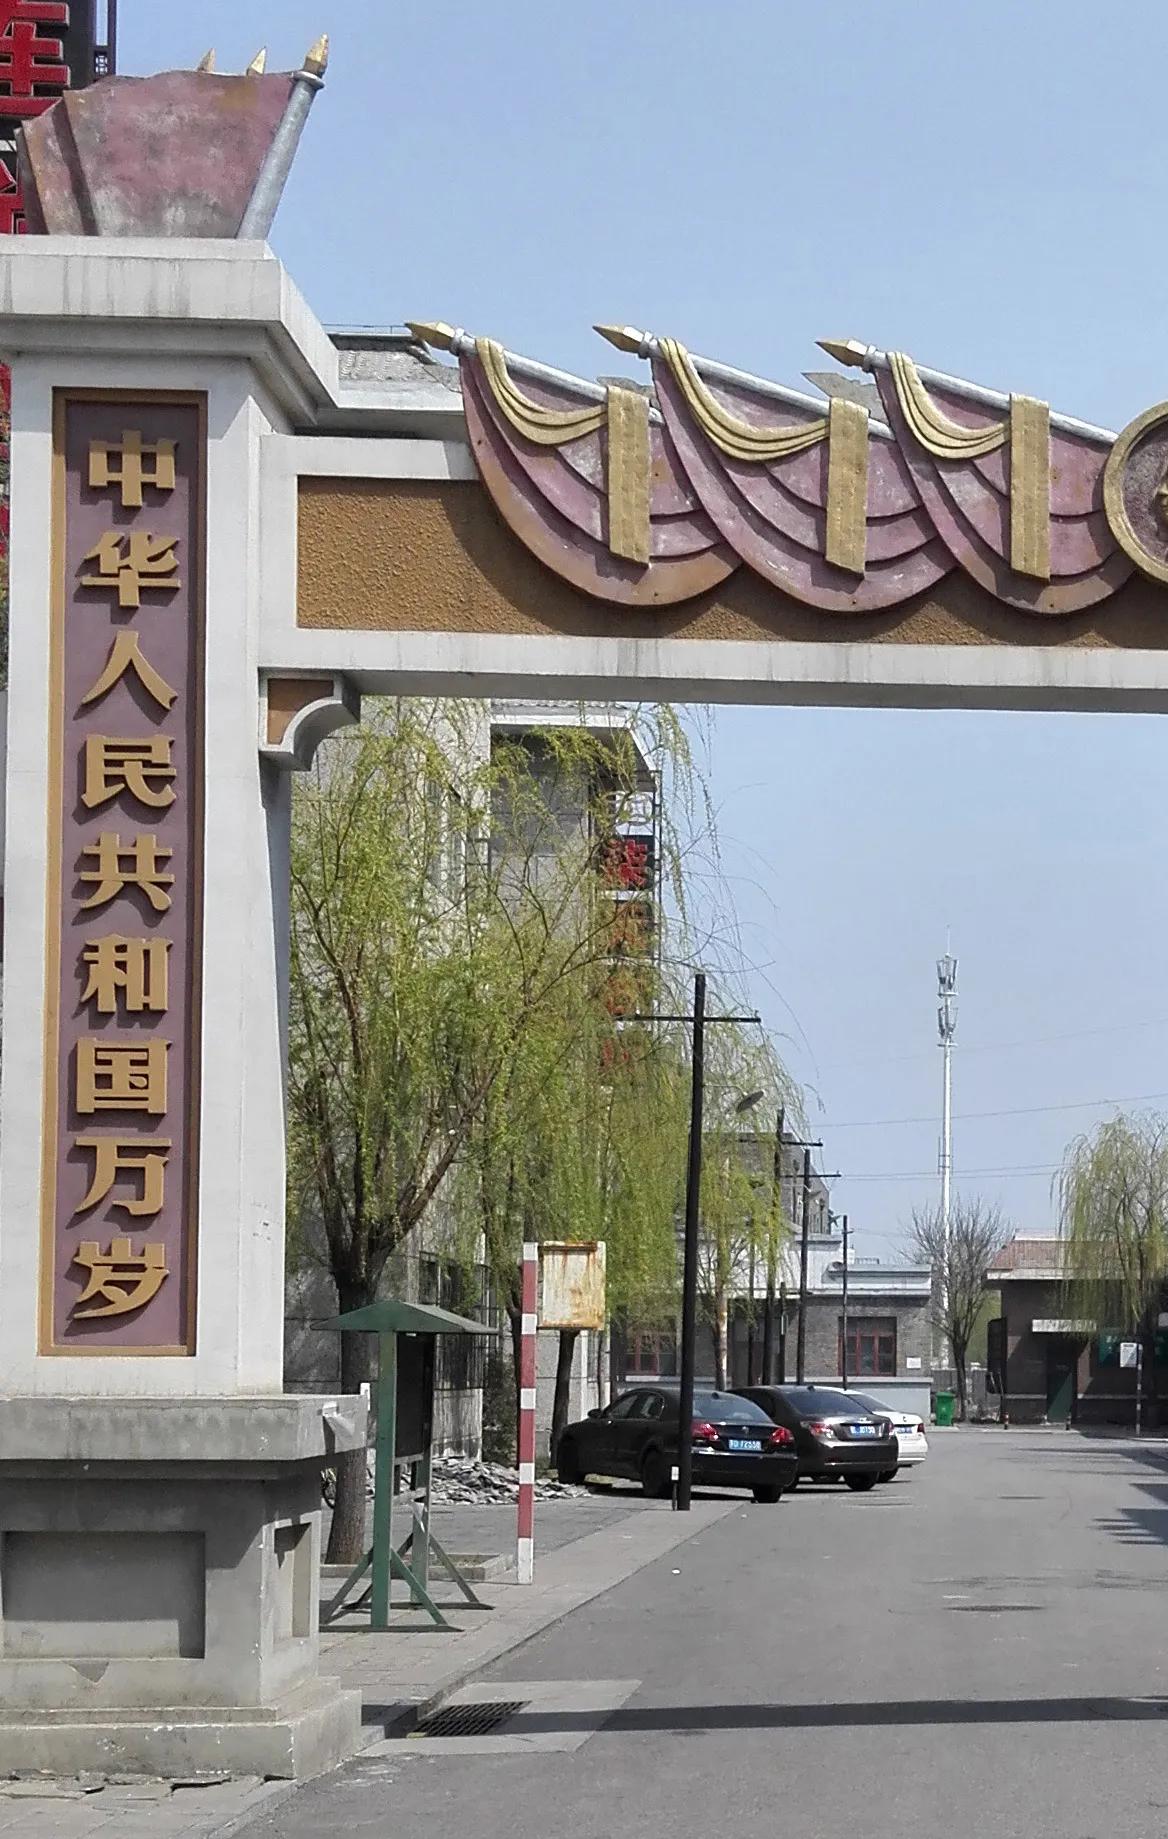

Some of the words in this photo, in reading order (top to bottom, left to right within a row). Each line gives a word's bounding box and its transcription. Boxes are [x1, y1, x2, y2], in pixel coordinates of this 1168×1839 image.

[73, 430, 181, 1320] 中华人民共和国万岁
